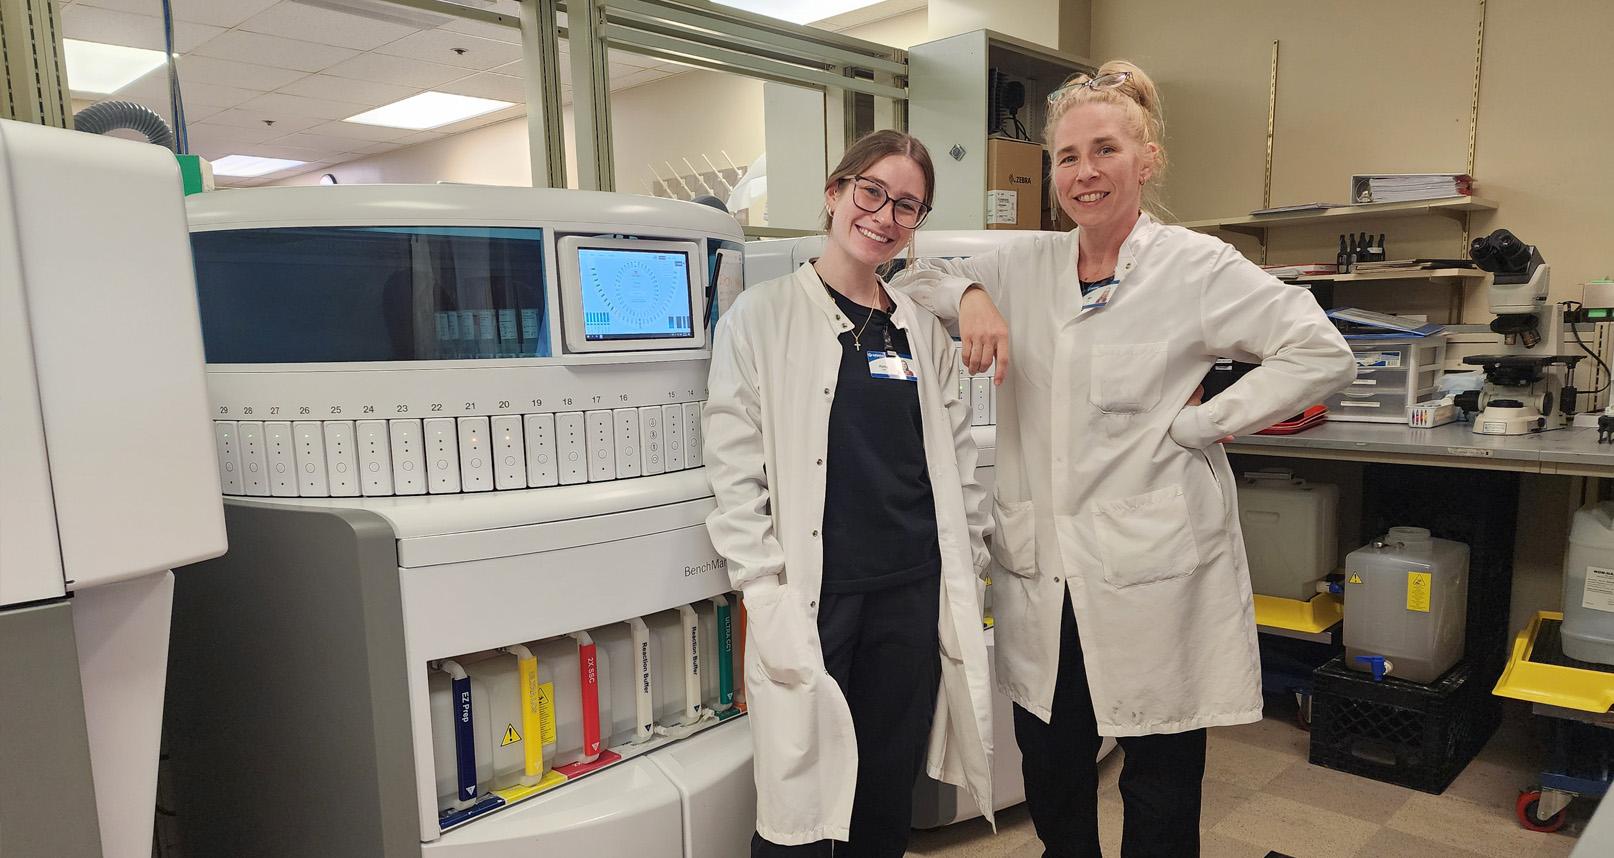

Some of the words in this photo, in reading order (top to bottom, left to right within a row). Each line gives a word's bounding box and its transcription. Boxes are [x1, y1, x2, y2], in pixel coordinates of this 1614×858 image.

[1016, 176, 1031, 184] ZEBRA
[687, 389, 694, 397] 14
[220, 406, 229, 414] 29
[243, 407, 253, 415] 28
[270, 407, 280, 415] 27
[299, 406, 310, 414] 26
[330, 406, 342, 414] 25
[363, 405, 374, 414] 24
[396, 404, 408, 413] 23
[431, 403, 443, 412] 22
[465, 402, 476, 410] 21
[498, 400, 510, 409] 20
[532, 399, 542, 407] 19
[562, 398, 573, 406] 18
[591, 396, 601, 404] 17
[619, 394, 628, 402] 16
[684, 559, 727, 577] BenchMar
[724, 616, 732, 639] ULTRA
[587, 656, 594, 667] 2X
[641, 641, 649, 672] Reaction
[461, 692, 470, 703] EZ
[461, 704, 470, 723] Prep
